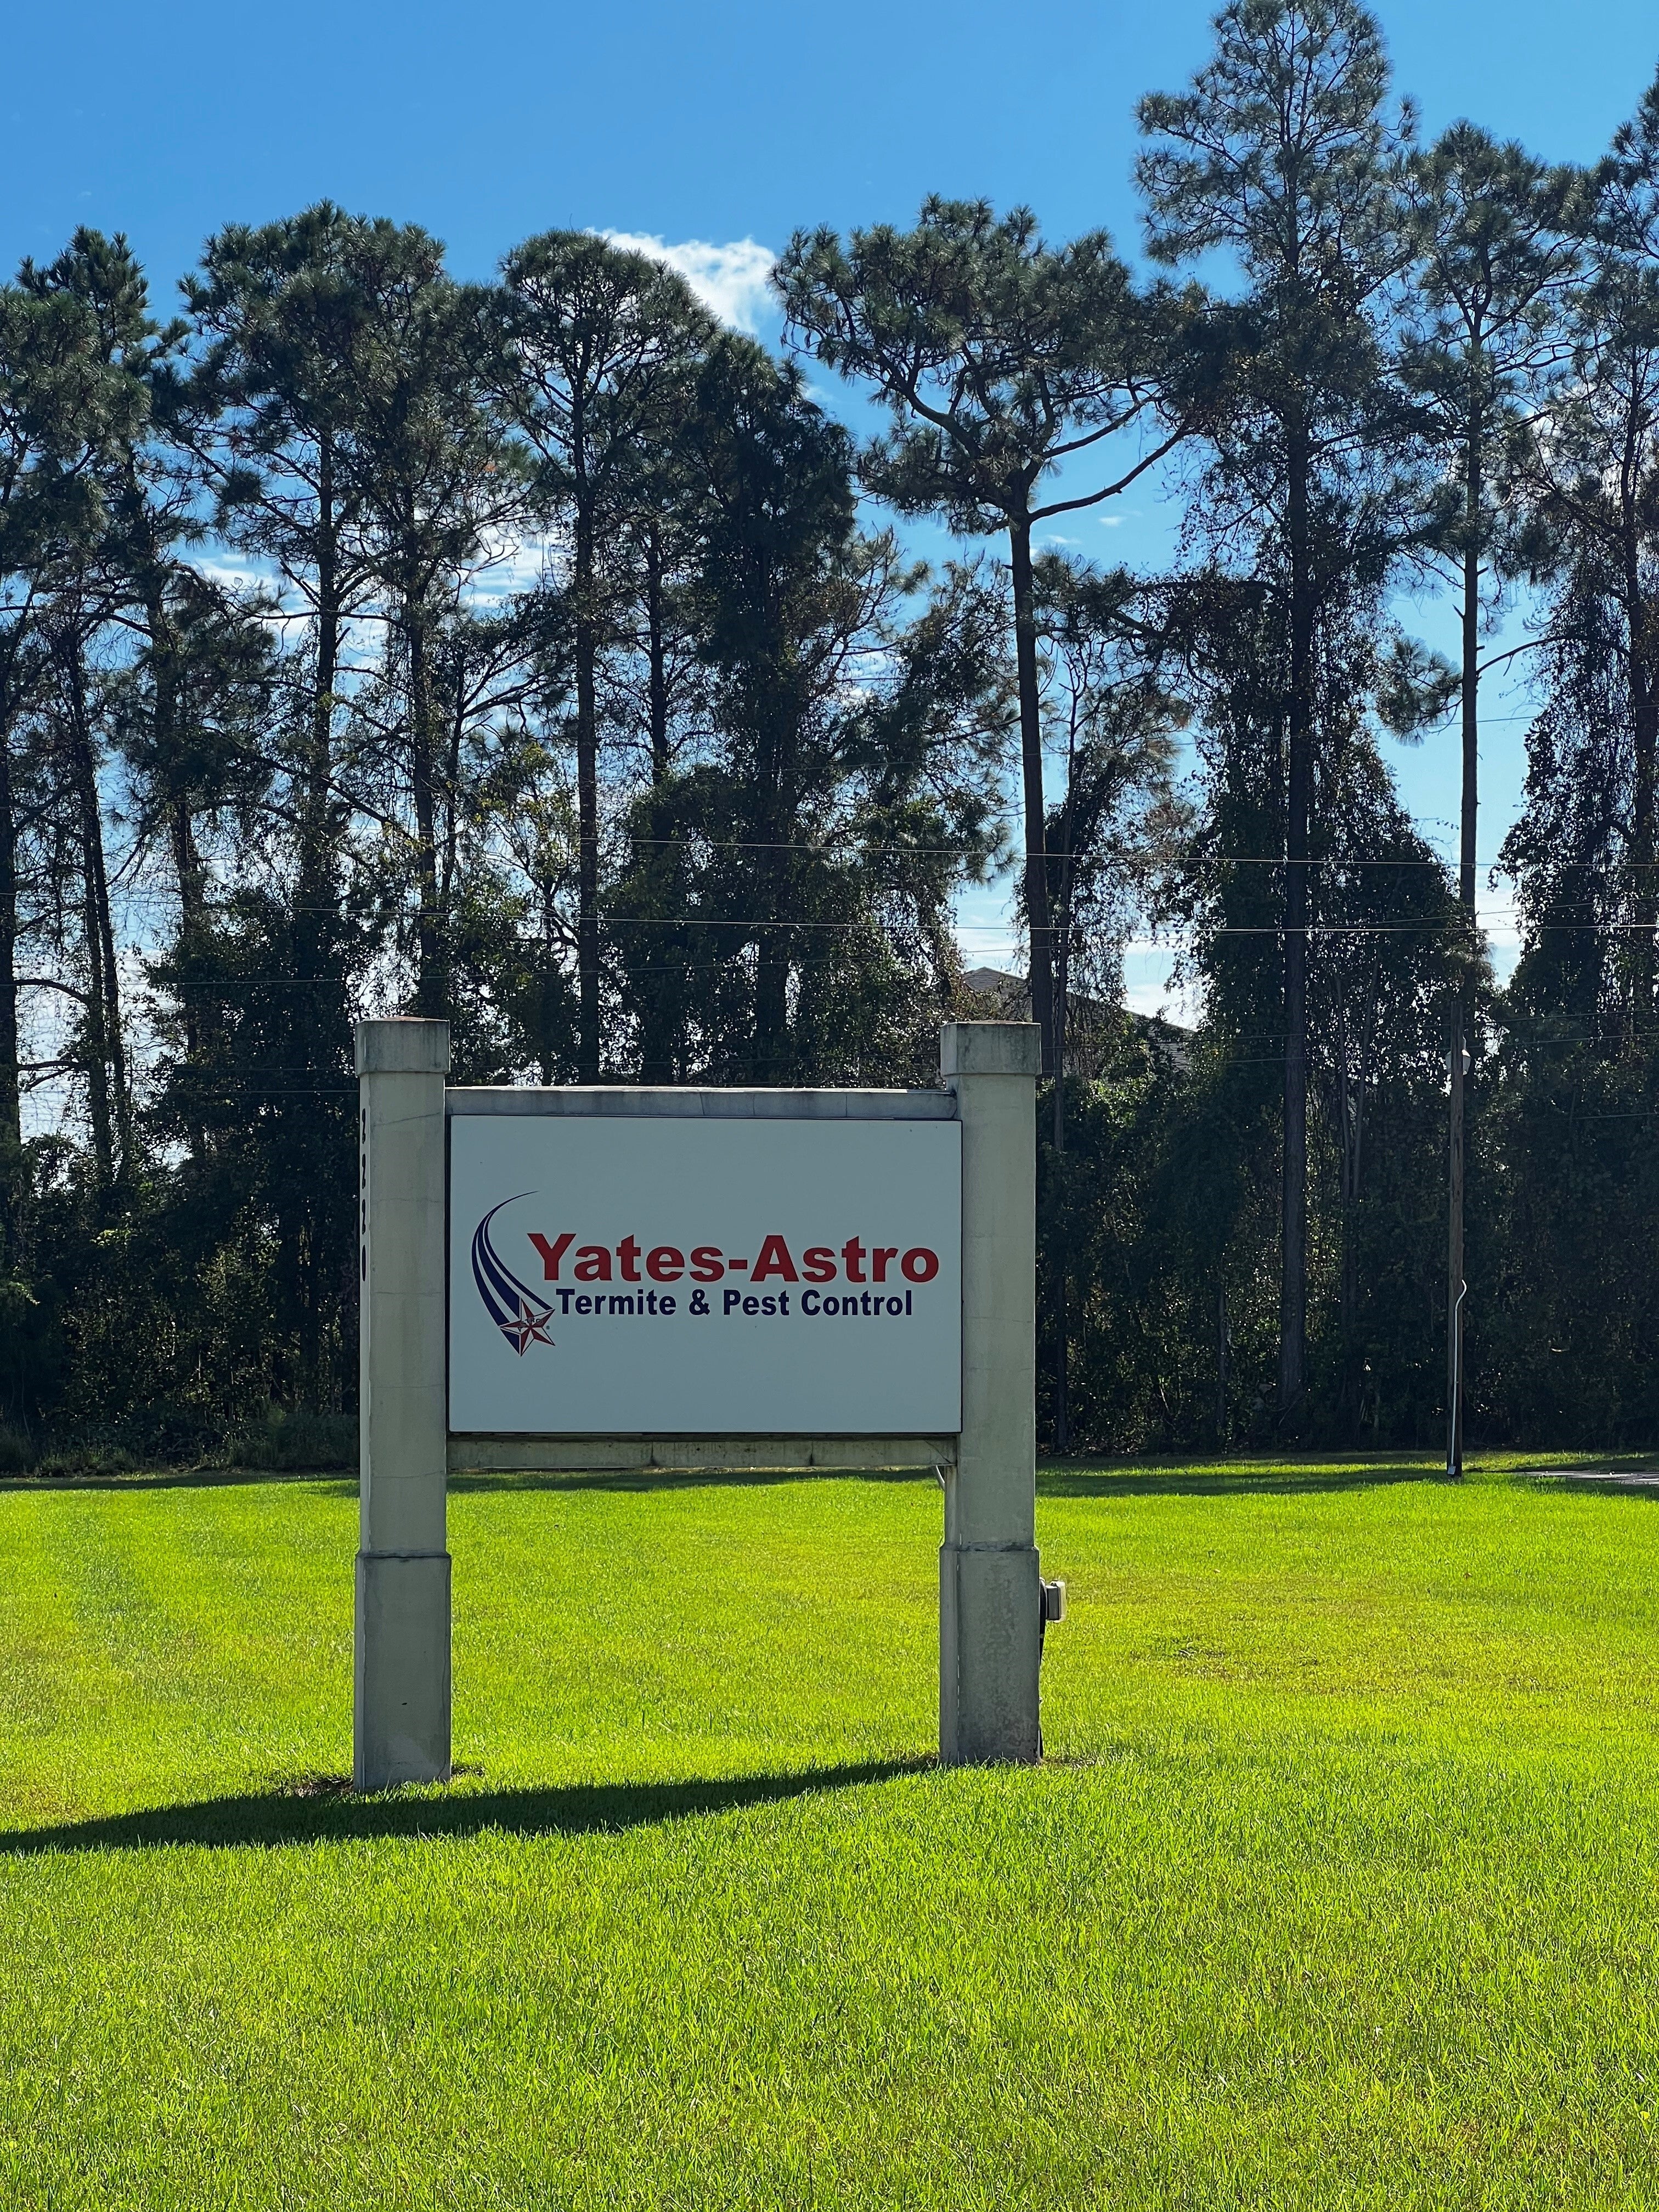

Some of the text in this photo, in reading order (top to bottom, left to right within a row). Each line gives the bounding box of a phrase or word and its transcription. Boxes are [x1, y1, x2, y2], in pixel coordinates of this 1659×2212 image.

[527, 1233, 939, 1283] Yates-Astro
[556, 1288, 912, 1316] Termite & Pest Control
